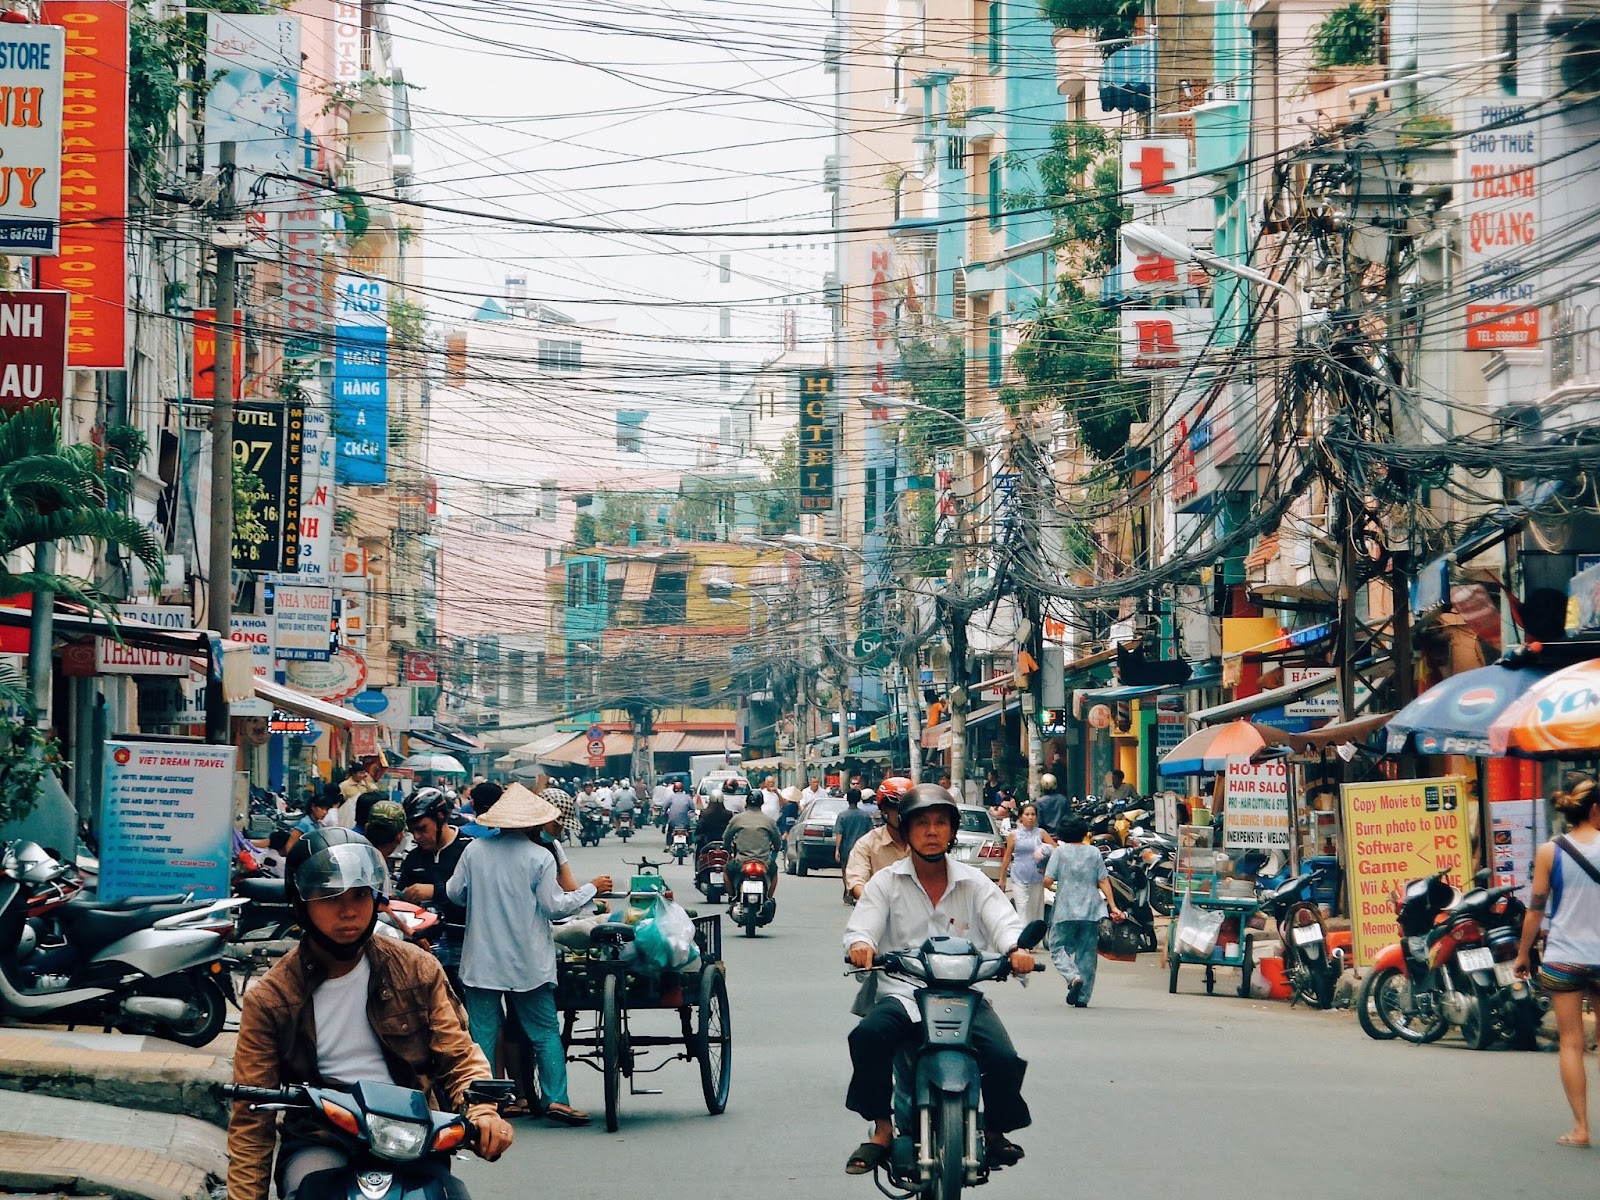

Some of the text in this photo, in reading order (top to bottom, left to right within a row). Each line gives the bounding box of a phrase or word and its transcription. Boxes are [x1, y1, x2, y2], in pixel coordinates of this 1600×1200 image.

[338, 3, 358, 84] HOTE
[0, 42, 51, 70] STORE
[1470, 134, 1496, 152] CHO
[58, 13, 99, 353] OLD PROPAGANDA POSTERS
[1471, 163, 1535, 198] THANH
[1469, 211, 1535, 253] QUANG
[343, 283, 380, 312] ACB
[871, 251, 889, 350] HAPPY
[1500, 283, 1535, 300] RENT
[195, 340, 238, 356] VIT
[343, 378, 380, 395] HÀNG
[804, 377, 833, 491] HOTEL
[285, 408, 303, 567] MONEY EXCHANGE
[299, 544, 312, 556] 3
[278, 590, 300, 608] NHÀ
[293, 623, 306, 631] BIKE
[139, 756, 225, 768] VIET DREAM TRAVEL
[1229, 780, 1256, 793] HAIR
[1353, 795, 1421, 814] Copy Movie to
[1356, 815, 1458, 837] Burn photo to DVD
[1227, 831, 1263, 844] INEXPENSIVE
[1356, 834, 1458, 856] Software PC
[1358, 854, 1462, 875] Game MAC
[1360, 879, 1390, 896] Wii &
